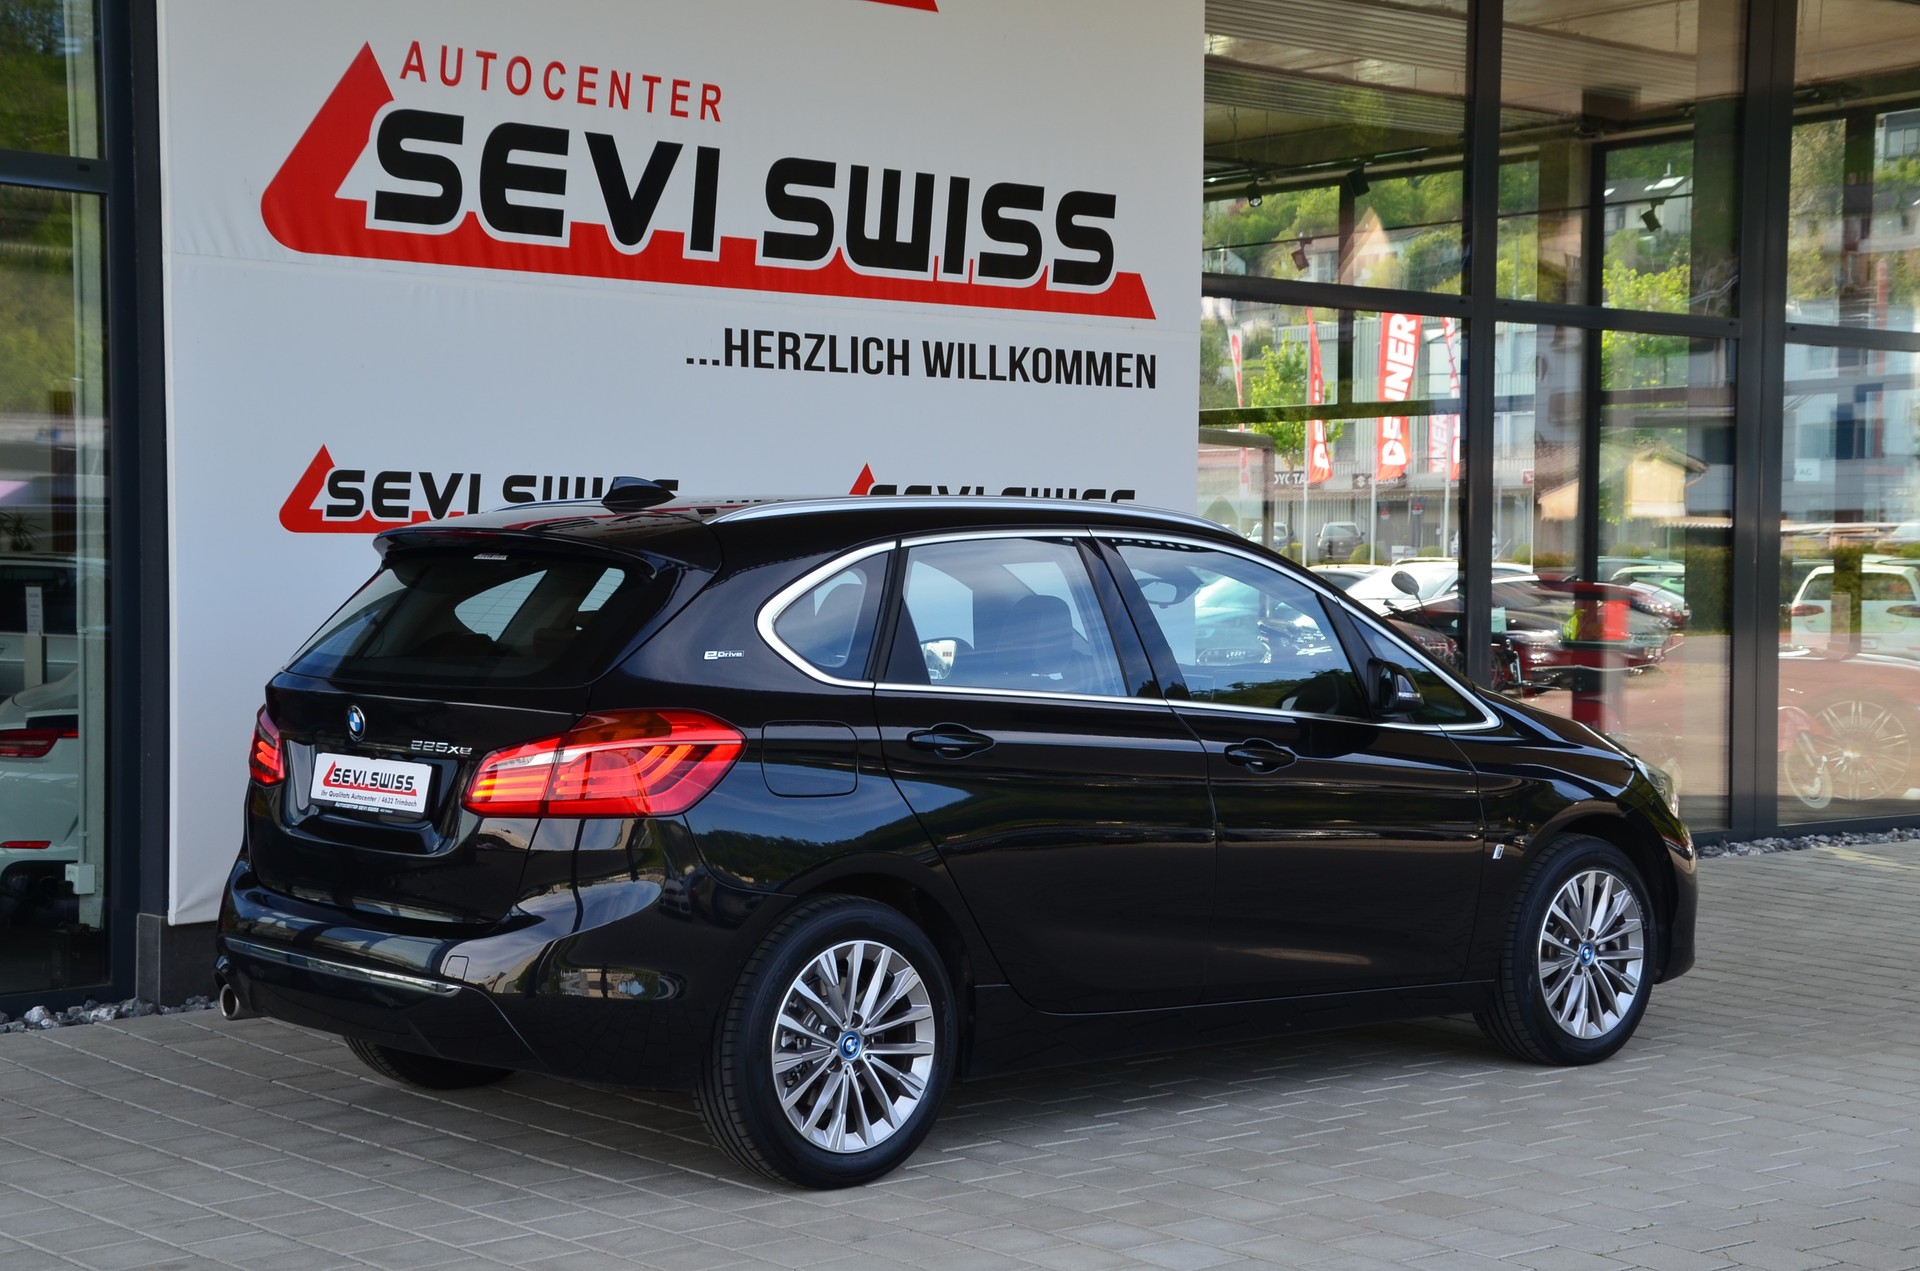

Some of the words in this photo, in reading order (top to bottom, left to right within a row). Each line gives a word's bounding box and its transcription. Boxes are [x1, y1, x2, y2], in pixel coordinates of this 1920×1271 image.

[401, 42, 722, 122] AUTOCENTER
[374, 109, 720, 252] SEVI
[763, 158, 1116, 285] SWISS
[922, 341, 1155, 388] WILLKOMMEN
[326, 470, 481, 519] SEVI
[704, 651, 742, 660] eDrive
[411, 740, 473, 755] 225xe
[332, 768, 367, 786] SEVI
[370, 771, 415, 791] SWISS
[351, 794, 377, 802] Autocenter
[395, 798, 417, 807] Trimbach
